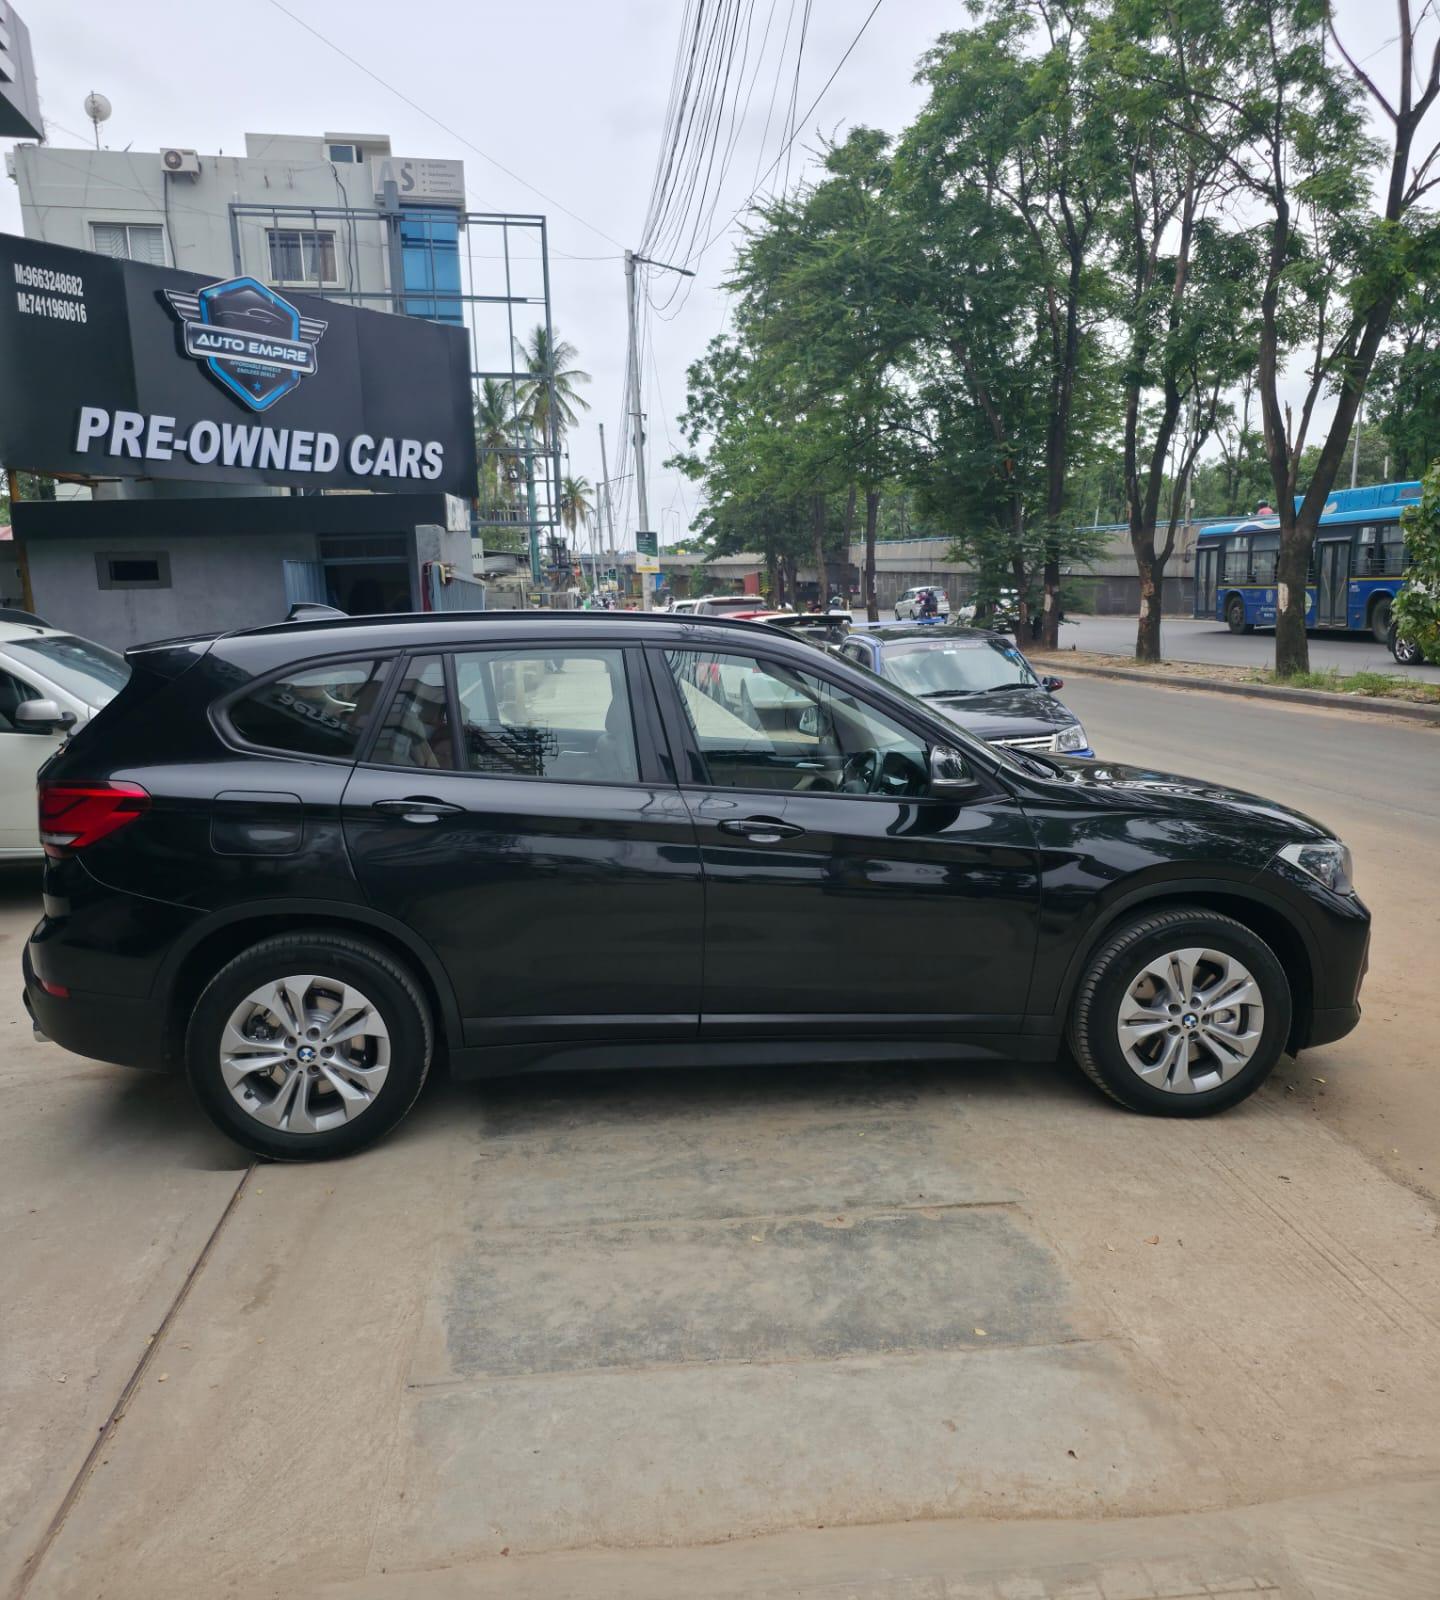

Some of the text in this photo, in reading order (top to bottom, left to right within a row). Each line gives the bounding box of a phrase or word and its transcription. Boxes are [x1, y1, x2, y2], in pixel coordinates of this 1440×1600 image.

[14, 263, 84, 297] M:9663248682
[17, 291, 87, 324] M:7411960616
[196, 333, 307, 362] AUTO EMPIRE
[76, 406, 444, 480] PRE-OWNED CARS
